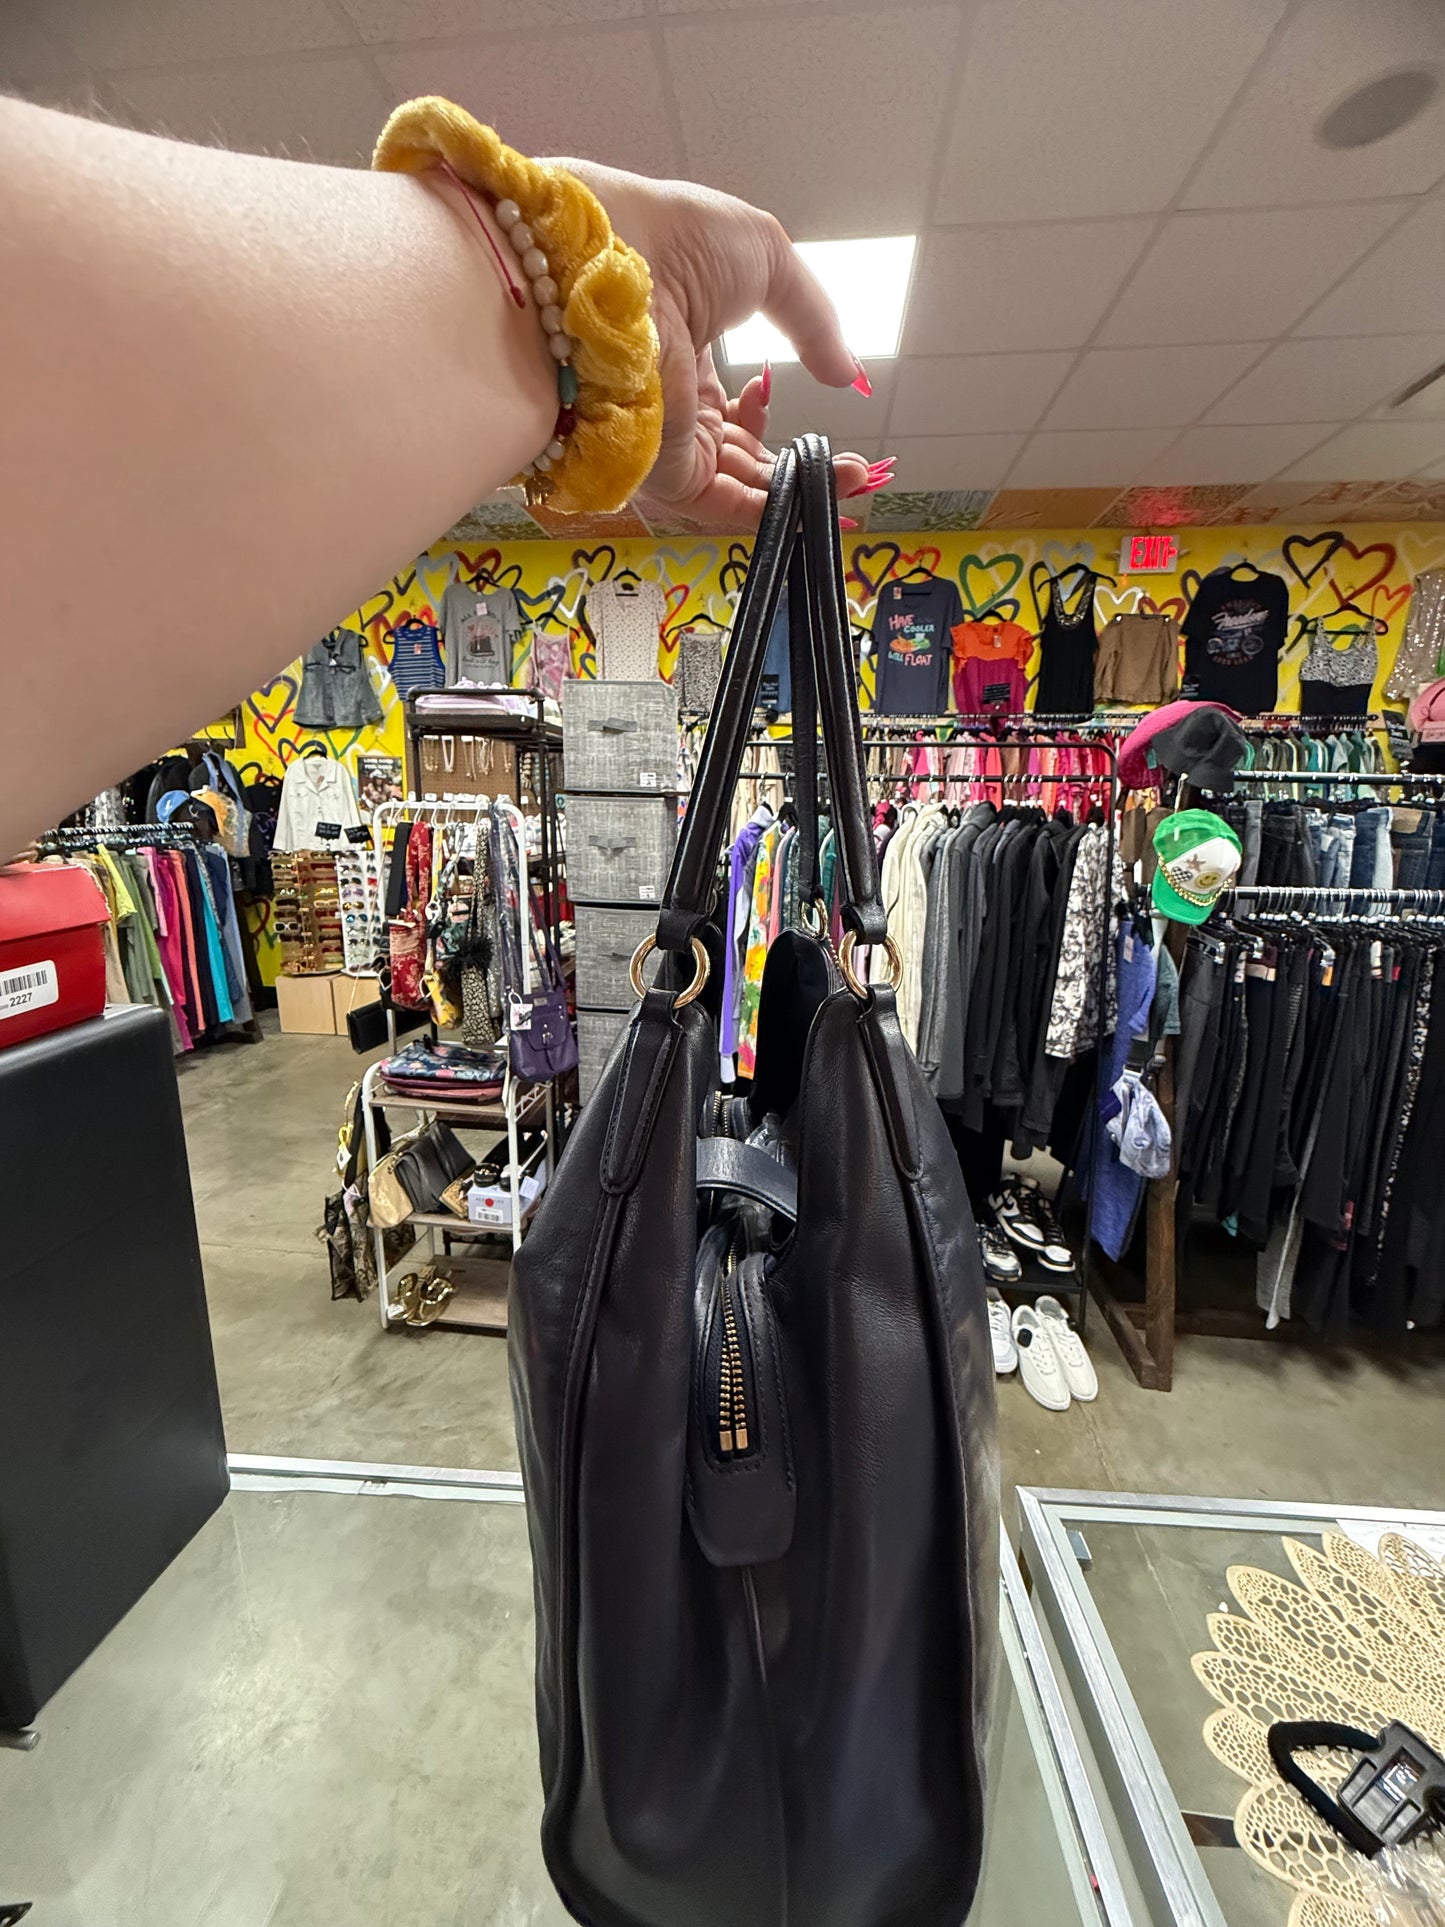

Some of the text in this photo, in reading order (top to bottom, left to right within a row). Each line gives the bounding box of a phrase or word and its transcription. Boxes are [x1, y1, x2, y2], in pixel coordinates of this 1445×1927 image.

[1129, 536, 1173, 569] EXIT
[888, 614, 915, 630] HAVE
[903, 624, 935, 633] COOLER
[904, 653, 933, 666] FLOAT
[10, 992, 32, 1007] 2227
